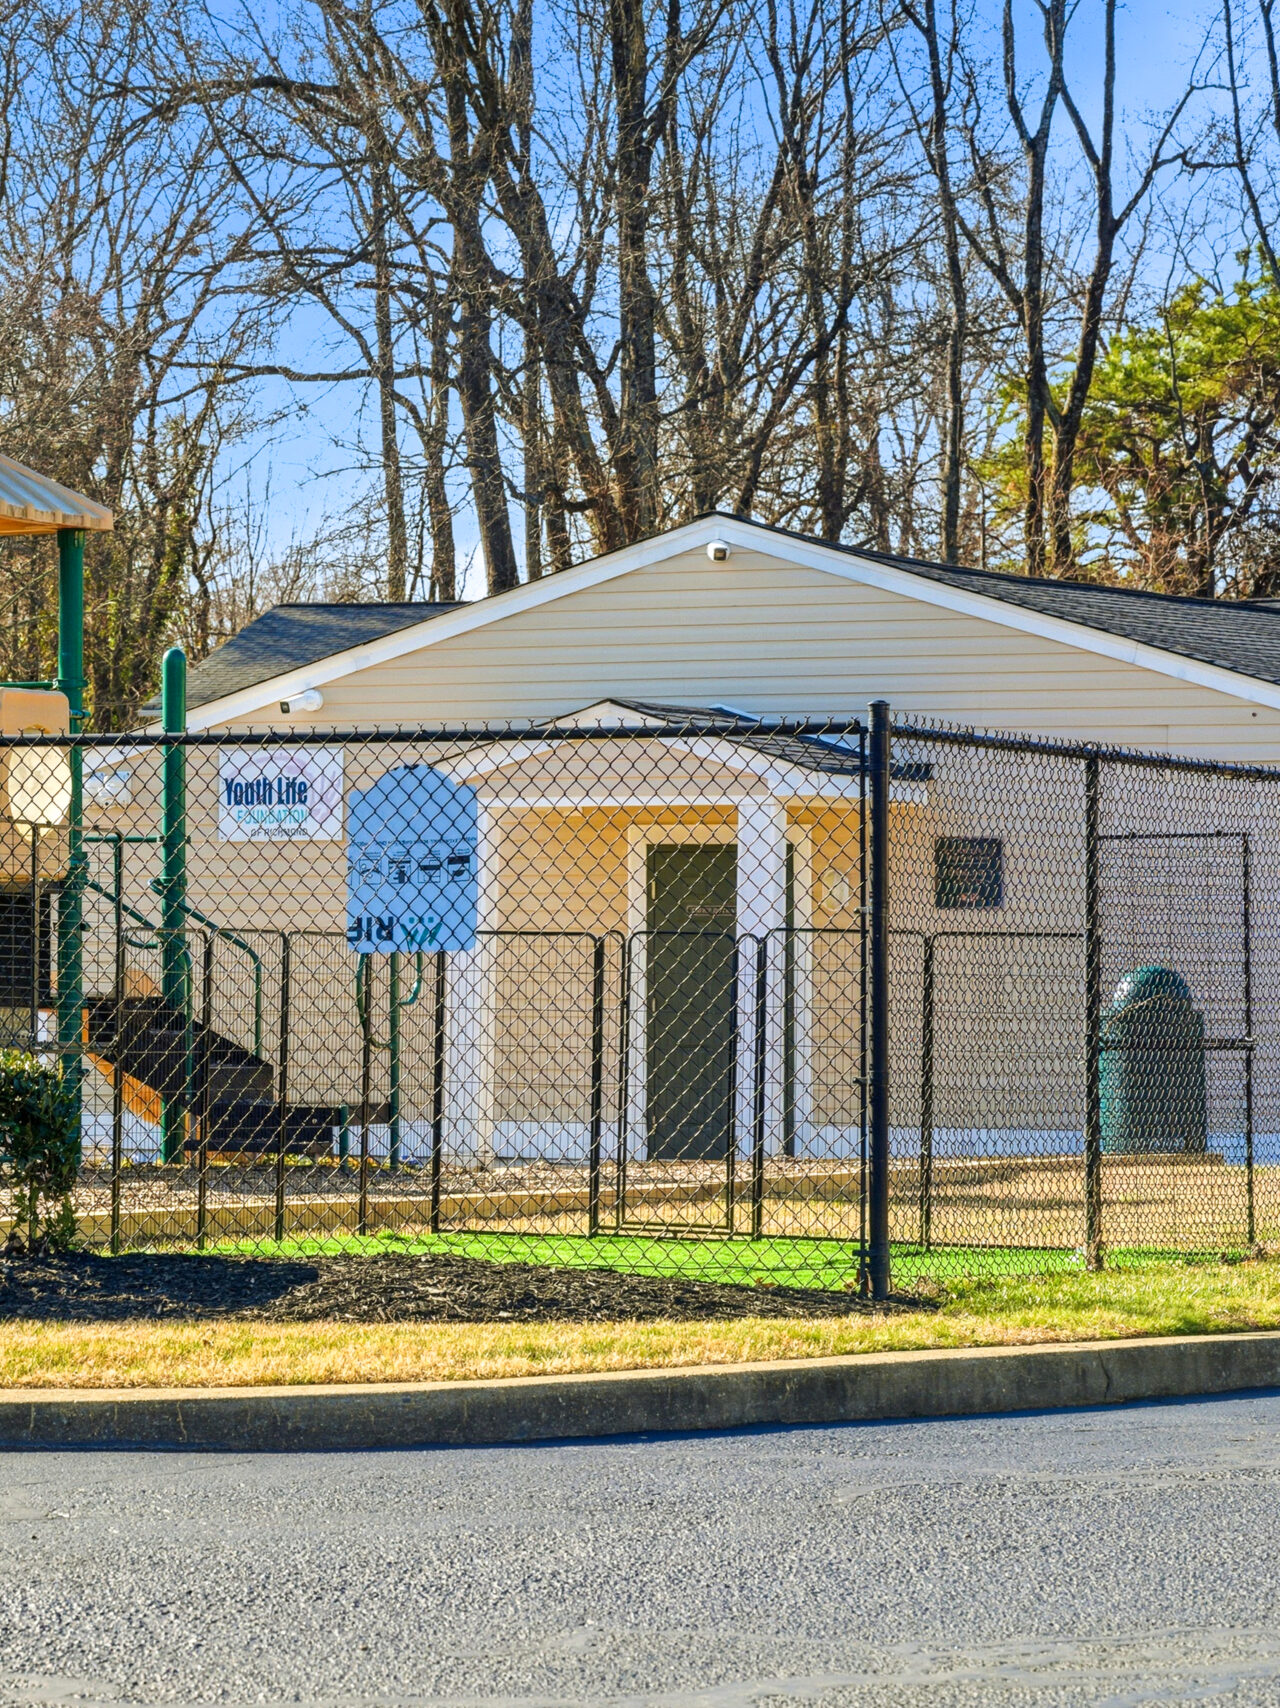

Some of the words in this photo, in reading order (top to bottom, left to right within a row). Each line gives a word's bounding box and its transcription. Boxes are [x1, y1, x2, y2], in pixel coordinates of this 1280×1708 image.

[224, 777, 272, 806] Youth
[277, 776, 308, 806] Life
[236, 809, 308, 824] FOUNDATION
